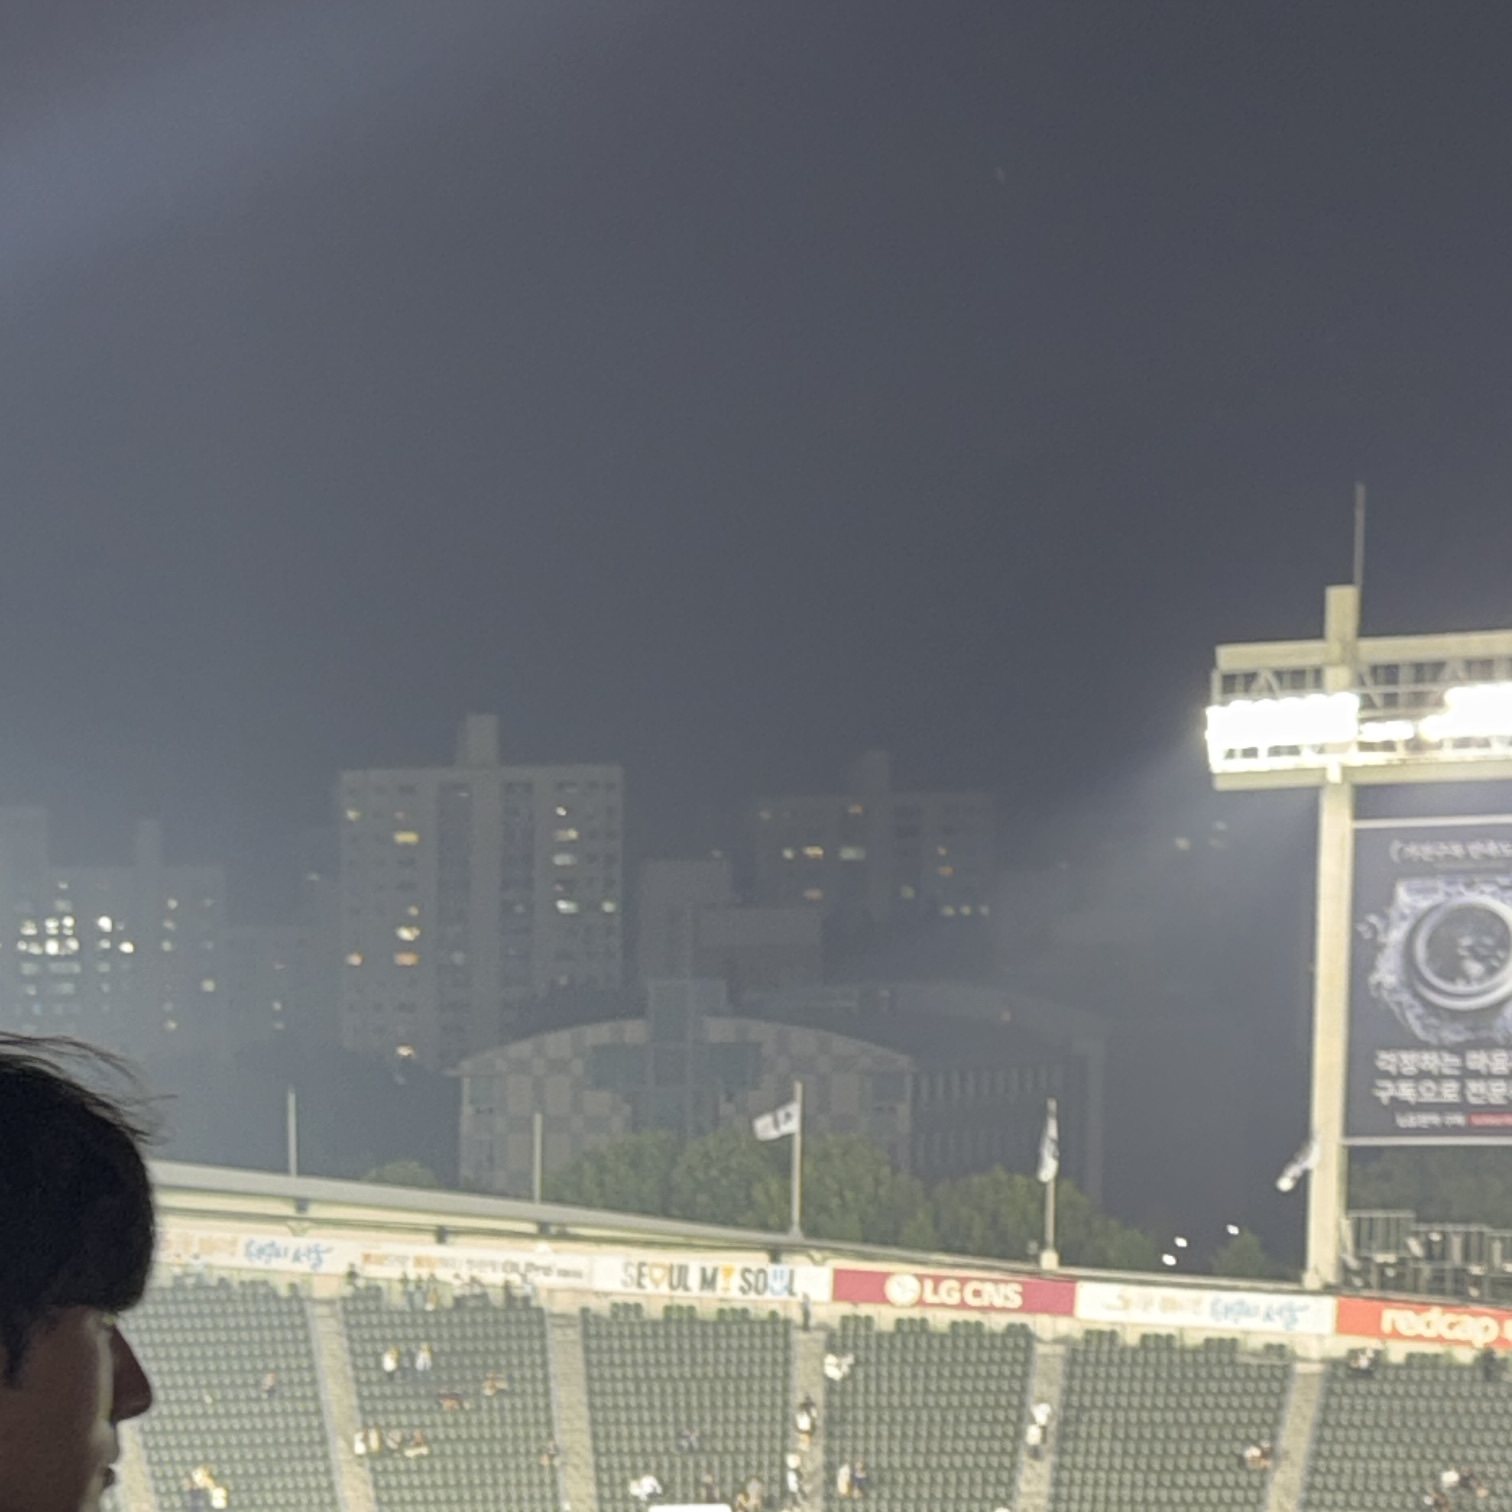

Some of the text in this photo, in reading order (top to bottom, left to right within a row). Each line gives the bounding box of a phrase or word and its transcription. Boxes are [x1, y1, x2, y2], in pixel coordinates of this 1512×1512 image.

[922, 1278, 1023, 1309] LG CNS
[1381, 1307, 1500, 1347] redcap
